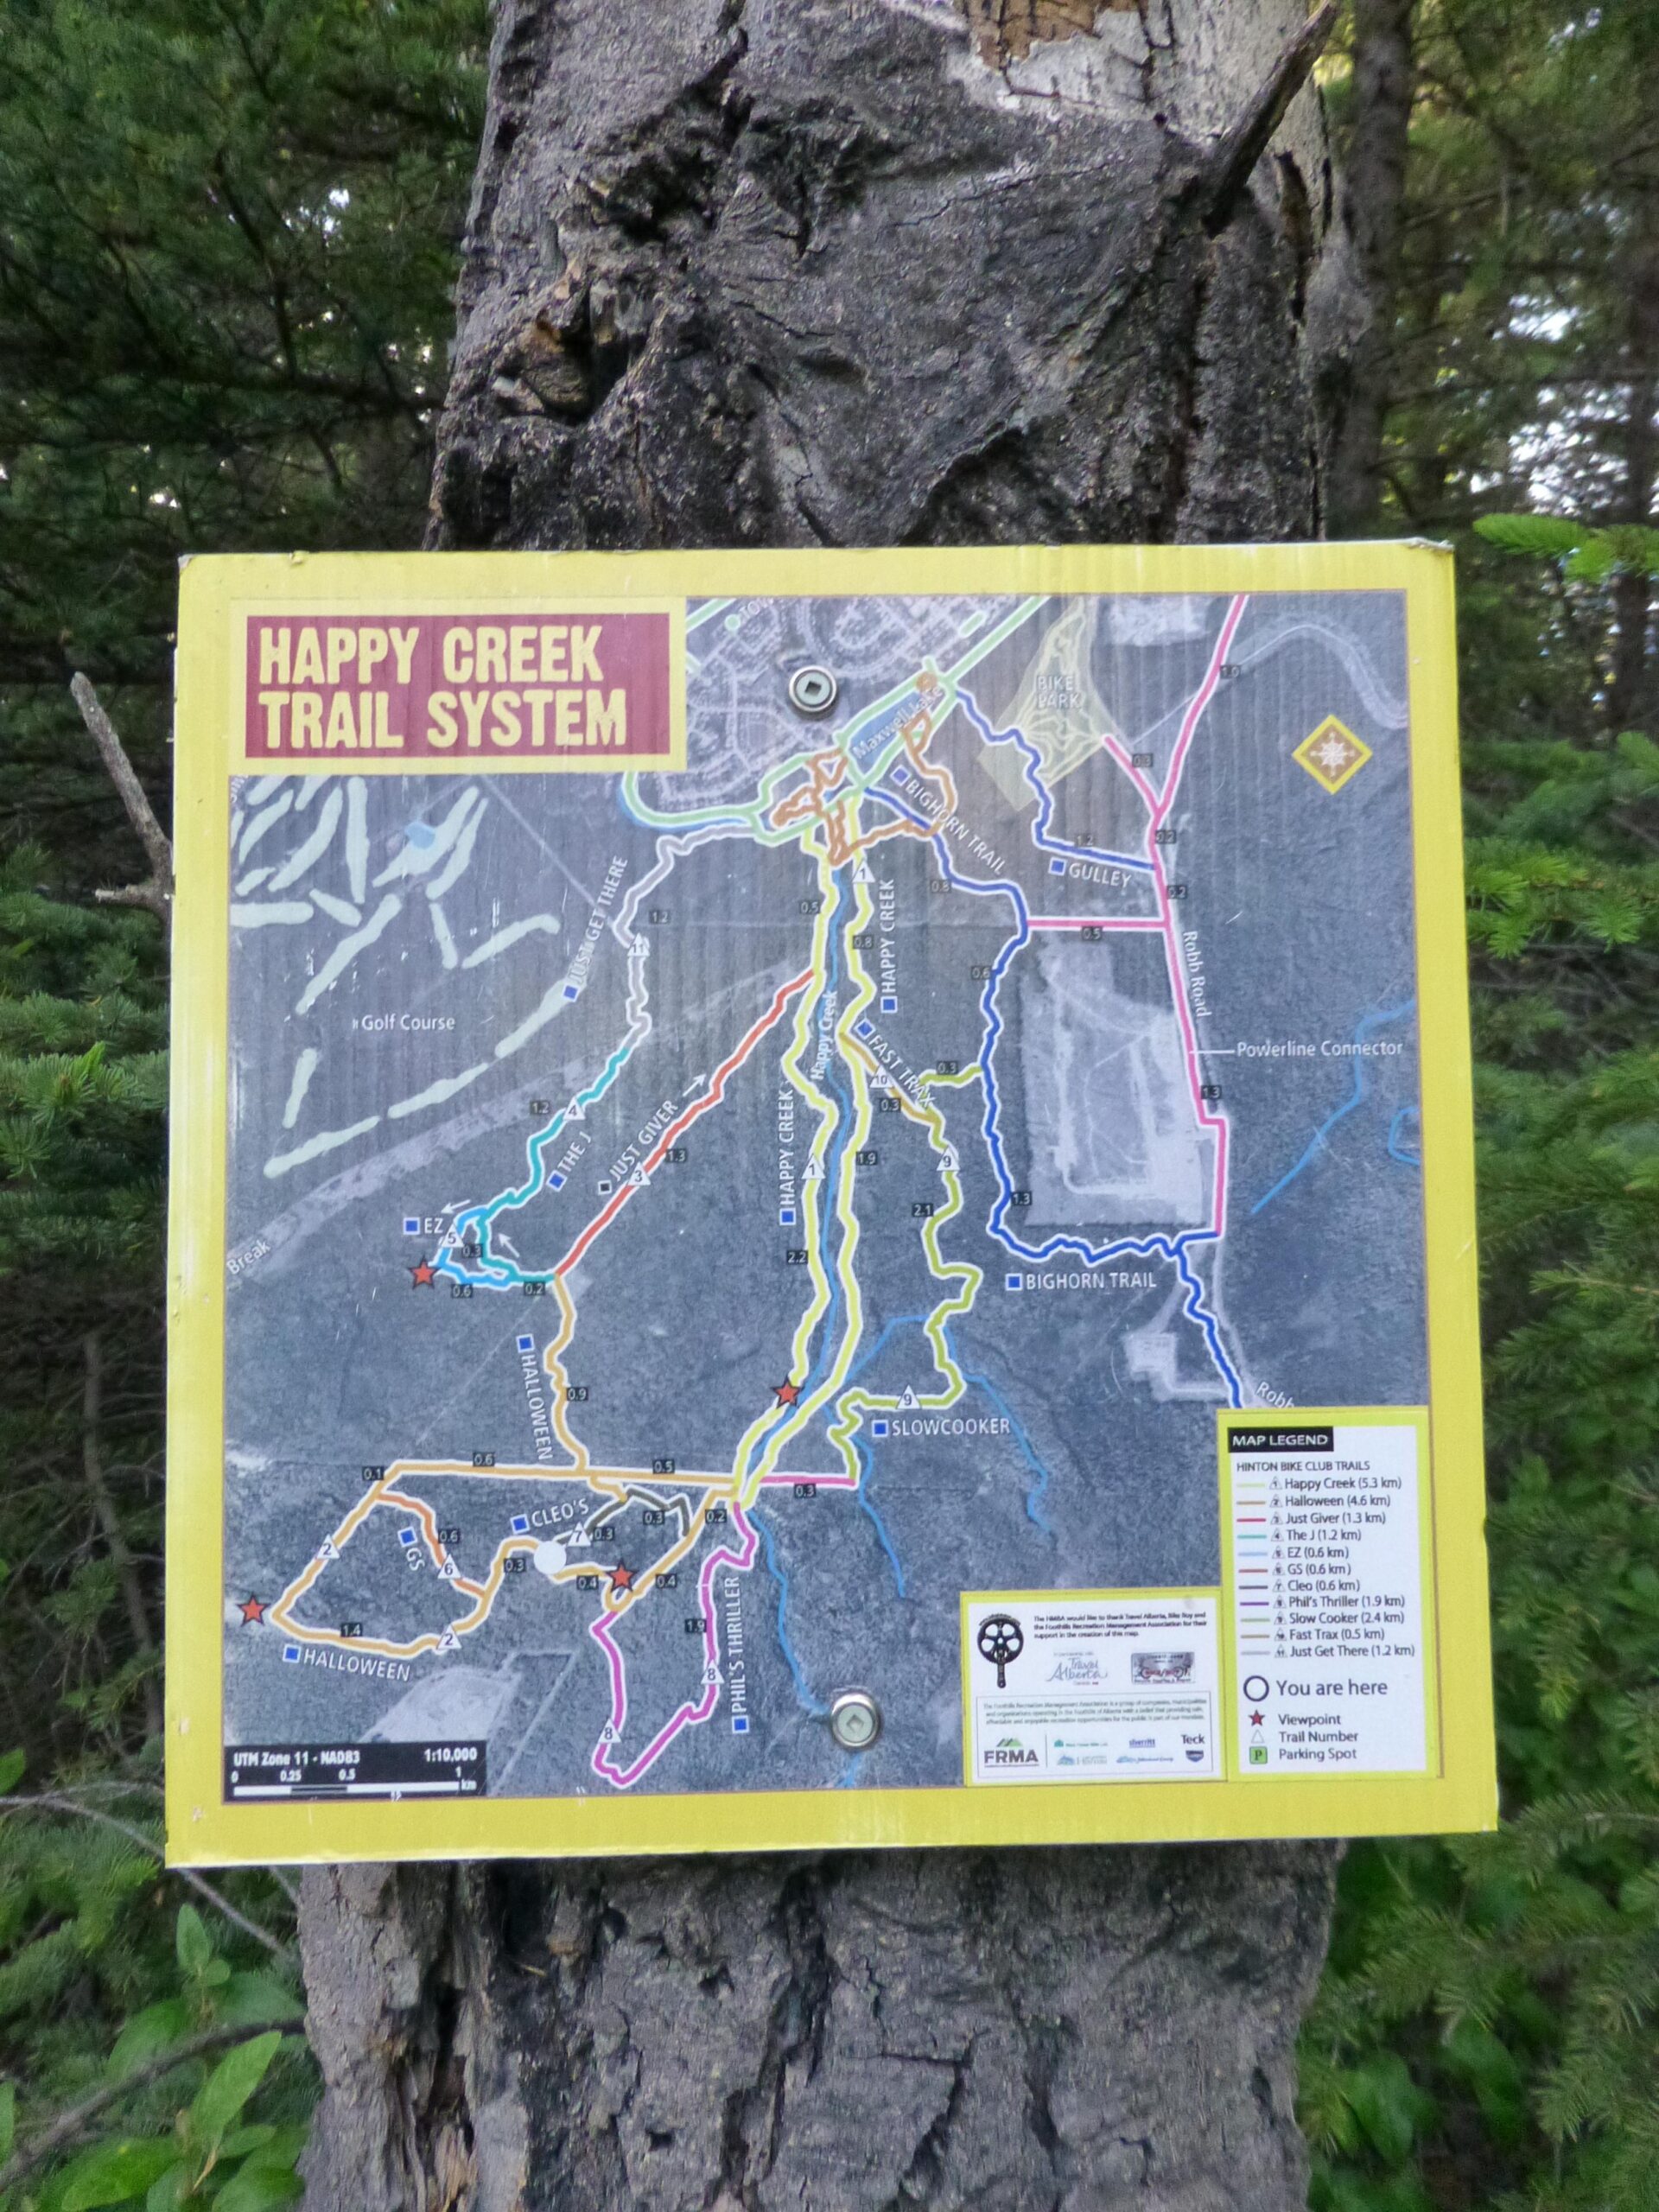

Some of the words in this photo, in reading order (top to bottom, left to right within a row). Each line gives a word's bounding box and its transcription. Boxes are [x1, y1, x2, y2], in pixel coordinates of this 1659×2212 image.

[259, 627, 420, 684] HAPPY
[442, 625, 604, 682] CREEK
[1038, 676, 1073, 690] BIKE
[1039, 693, 1079, 708] PARK
[258, 691, 404, 749] TRAIL
[427, 689, 626, 747] SYSTEM
[852, 706, 908, 759] Maxwell
[906, 779, 970, 840] BIGHORN
[968, 834, 1005, 875] TRAIL
[1069, 863, 1132, 888] GULLEY
[585, 908, 607, 941] GET
[598, 855, 628, 906] THERE
[801, 902, 819, 913] 0.5
[879, 879, 895, 932] CREEK
[652, 912, 669, 924] 1.2
[1084, 929, 1100, 939] 0.5
[1183, 931, 1204, 973] Robb
[880, 938, 896, 993] HAPPY
[1191, 976, 1211, 1018] Road
[818, 990, 838, 1032] Creek
[361, 1014, 395, 1031] Golf
[400, 1014, 455, 1031] Course
[1237, 1040, 1315, 1057] Powerline
[1321, 1040, 1403, 1056] Connector
[810, 1032, 833, 1080] Happy
[868, 1037, 903, 1068] FAST
[899, 1068, 935, 1107] TRAX
[938, 1063, 957, 1074] 0.3
[532, 1102, 549, 1114] 1.2
[569, 1106, 577, 1116] 4
[881, 1100, 899, 1110] 0.3
[779, 1089, 794, 1141] CREEK
[609, 1143, 640, 1181] JUST
[638, 1100, 679, 1145] GIVER
[557, 1141, 586, 1173] THE
[579, 1131, 591, 1143] J
[668, 1150, 685, 1161] 1.3
[859, 1154, 875, 1164] 1.9
[944, 1156, 950, 1166] 9
[635, 1171, 643, 1182] 3
[779, 1146, 795, 1206] HAPPY
[1013, 1193, 1030, 1205] 1.3
[914, 1205, 931, 1215] 2.1
[424, 1218, 443, 1234] EZ
[448, 1233, 456, 1244] 5
[226, 1239, 271, 1275] Break
[788, 1253, 806, 1263] 2.2
[1027, 1274, 1105, 1289] BIGHORN
[1109, 1273, 1157, 1287] TRAIL
[453, 1286, 471, 1296] 0.6
[525, 1283, 543, 1294] 0.2
[568, 1389, 587, 1400] 0.9
[904, 1394, 912, 1405] 9
[521, 1354, 554, 1460] HALLOWEEN
[892, 1418, 1010, 1436] SLOWCOOKER
[1232, 1435, 1266, 1446] MAP
[1269, 1434, 1328, 1446] LEGEND
[474, 1454, 493, 1465] 0.6
[655, 1461, 673, 1472] 0.5
[1236, 1463, 1277, 1471] HINTON
[1281, 1462, 1303, 1471] BIKE
[1305, 1462, 1333, 1471] CLUB
[1335, 1461, 1370, 1470] TRAILS
[364, 1469, 382, 1480] 0.1
[1285, 1478, 1321, 1491] Happy
[1324, 1478, 1355, 1489] Creek
[1358, 1478, 1378, 1490] (5.3
[1381, 1477, 1402, 1489] km)
[796, 1486, 814, 1497] 0.3
[1286, 1496, 1344, 1507] Halloween
[1347, 1495, 1367, 1507] (4.6
[1370, 1495, 1391, 1507] km)
[531, 1497, 589, 1528] CLEO'S
[645, 1513, 663, 1523] 0.3
[707, 1512, 725, 1522] 0.2
[1285, 1513, 1308, 1524] Just
[1310, 1513, 1340, 1524] Giver
[1343, 1512, 1362, 1524] (1.3
[1364, 1512, 1386, 1524] km)
[440, 1531, 458, 1541] 0.6
[575, 1530, 582, 1542] 7
[594, 1529, 613, 1540] 0.3
[1287, 1529, 1307, 1541] The
[1309, 1530, 1315, 1541] J
[1318, 1529, 1338, 1541] (1.2
[1340, 1529, 1361, 1541] km)
[323, 1543, 332, 1555] 2
[1287, 1548, 1301, 1558] EZ
[1304, 1547, 1324, 1559] (0.6
[1327, 1546, 1349, 1559] km)
[406, 1548, 425, 1571] GS
[506, 1560, 524, 1570] 0.3
[445, 1563, 453, 1575] 6
[1287, 1564, 1303, 1574] GS
[1306, 1564, 1325, 1576] (0.6
[578, 1578, 597, 1588] 0.4
[658, 1577, 677, 1586] 0.4
[1287, 1580, 1313, 1592] Cleo
[1315, 1580, 1336, 1592] (0.6
[1338, 1580, 1360, 1592] km)
[1289, 1597, 1318, 1607] Phil's
[1320, 1596, 1358, 1607] Thriller
[1362, 1595, 1382, 1607] (1.9
[1384, 1595, 1405, 1607] km)
[725, 1576, 744, 1656] THRILLER
[1289, 1613, 1316, 1624] Slow
[1319, 1612, 1358, 1624] Cooker
[1361, 1612, 1382, 1624] (2.4
[1383, 1611, 1404, 1624] km)
[344, 1624, 361, 1636] 1.4
[687, 1621, 704, 1631] 1.9
[445, 1633, 454, 1645] 2
[1289, 1630, 1312, 1640] Fast
[1314, 1629, 1338, 1640] Trax
[1341, 1629, 1361, 1641] (0.5
[1363, 1628, 1385, 1640] km)
[1289, 1646, 1312, 1657] Just
[1314, 1645, 1334, 1656] Get
[1337, 1645, 1369, 1656] There
[1371, 1644, 1391, 1657] (1.2
[1394, 1643, 1414, 1656] km)
[304, 1649, 410, 1681] HALLOWEEN
[708, 1668, 715, 1680] 8
[728, 1660, 747, 1713] PHIL'S
[1276, 1680, 1310, 1696] You
[1316, 1683, 1344, 1695] are
[1349, 1679, 1388, 1694] here
[1278, 1713, 1341, 1727] Viewpoint
[605, 1727, 613, 1739] 8
[1280, 1731, 1305, 1743] Trail
[1308, 1731, 1358, 1742] Number
[1181, 1734, 1205, 1745] Teck
[234, 1751, 258, 1766] UTM
[262, 1751, 290, 1765] Zone
[295, 1751, 308, 1764] 11
[321, 1750, 360, 1764] NAD83
[984, 1750, 1039, 1764] FRMA
[1279, 1748, 1325, 1762] Parking
[1328, 1748, 1357, 1762] Spot
[231, 1771, 238, 1783] 0
[280, 1770, 302, 1782] 0.25
[339, 1769, 355, 1781] 0.5
[455, 1767, 461, 1778] 1
[461, 1779, 476, 1790] km
